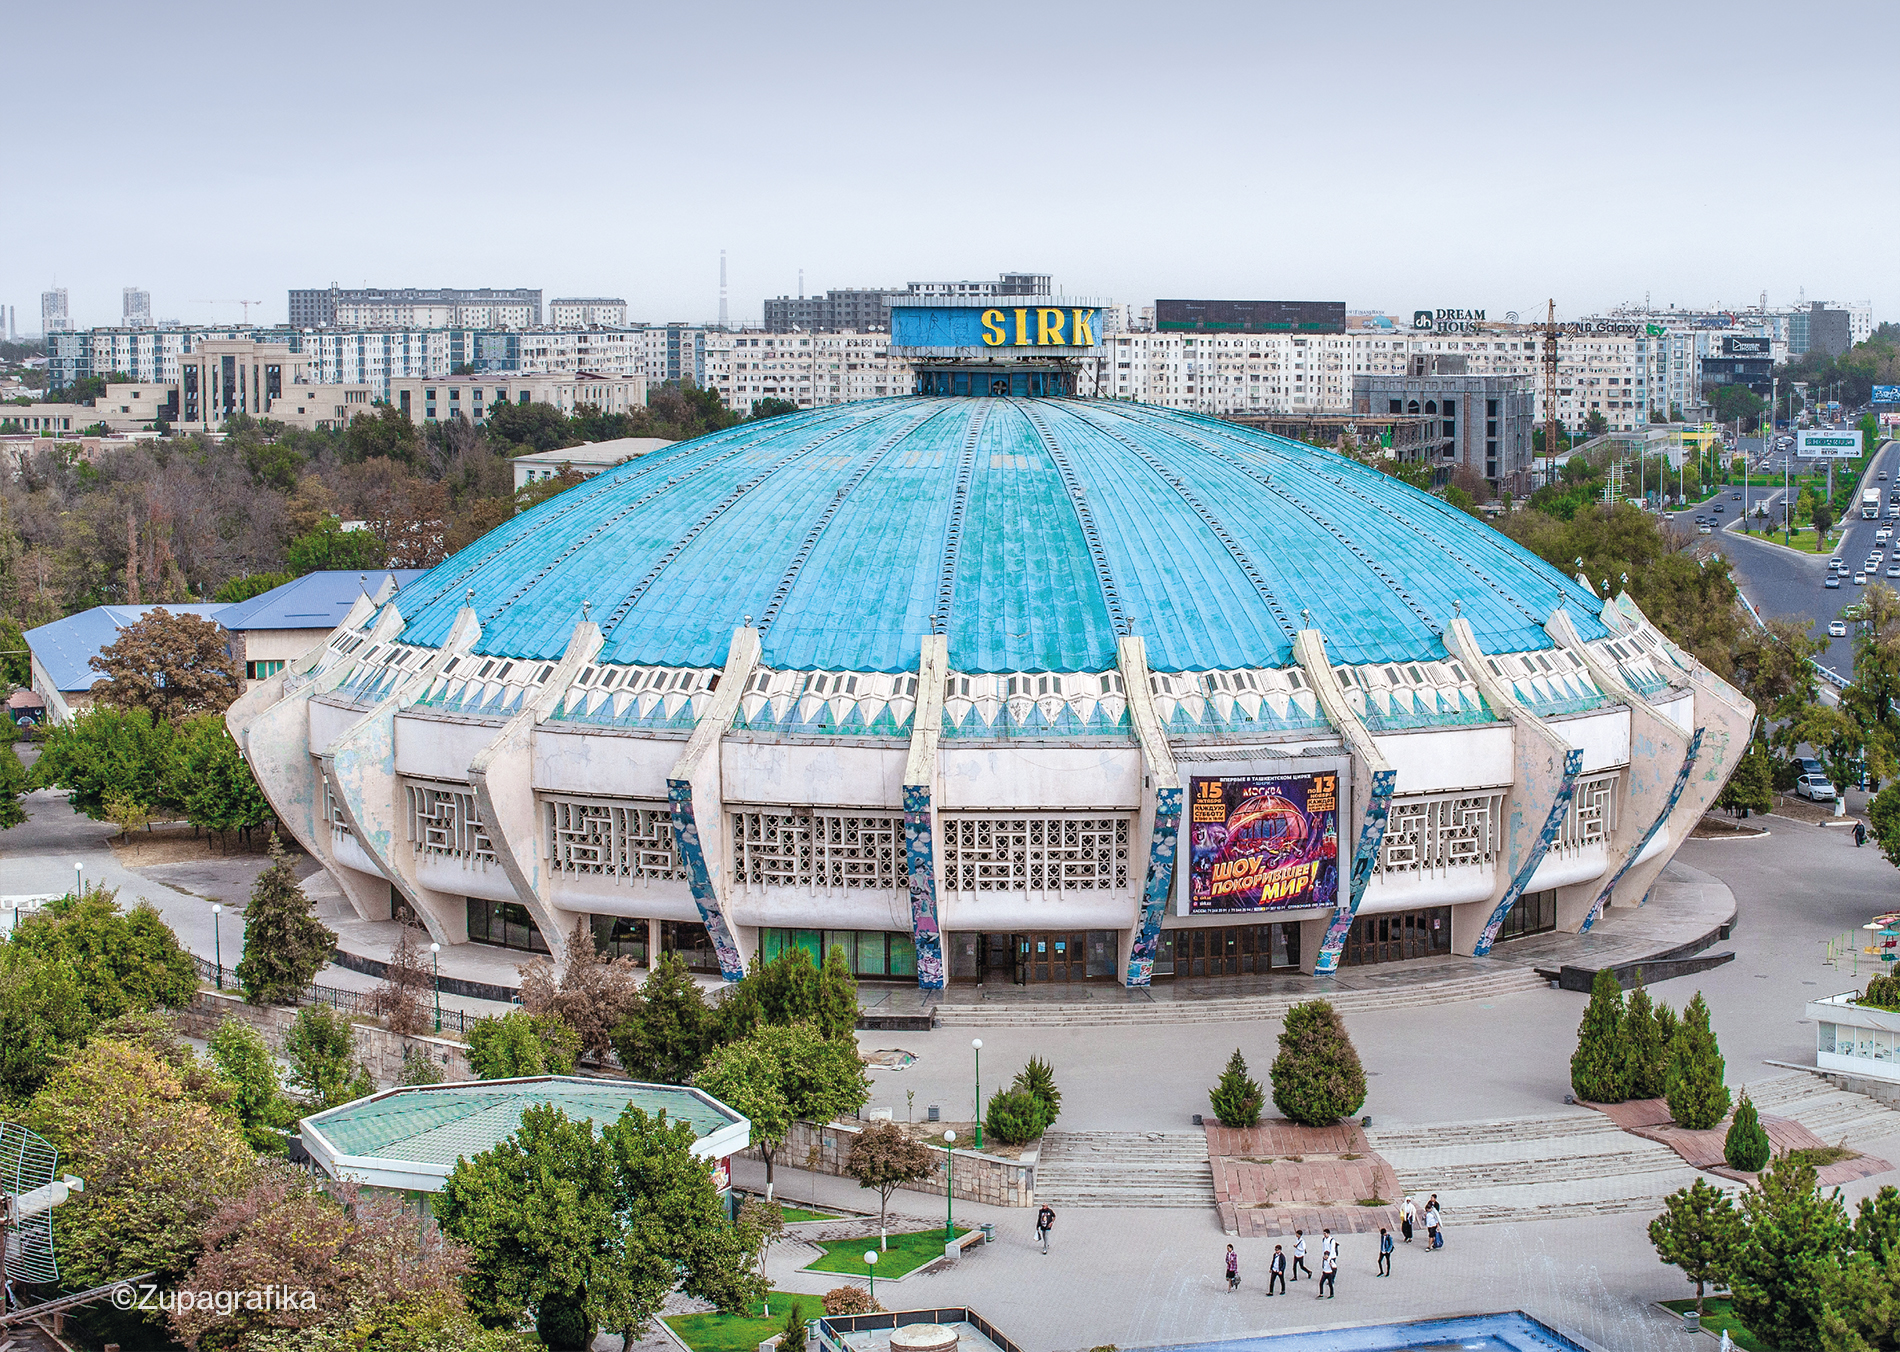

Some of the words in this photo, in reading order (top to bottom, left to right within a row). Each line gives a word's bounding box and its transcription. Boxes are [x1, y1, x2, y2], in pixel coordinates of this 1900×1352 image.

[1436, 309, 1486, 320] DREAM
[981, 308, 1095, 346] SIRK
[1596, 322, 1640, 335] Galaxy
[1200, 781, 1223, 798] 15
[1243, 787, 1282, 796] МОСКВА
[1313, 775, 1335, 793] 13
[1212, 855, 1266, 881] ШОУ,
[1211, 863, 1310, 896] ПОКОРИВШЕЕ
[1260, 860, 1319, 903] МИР!
